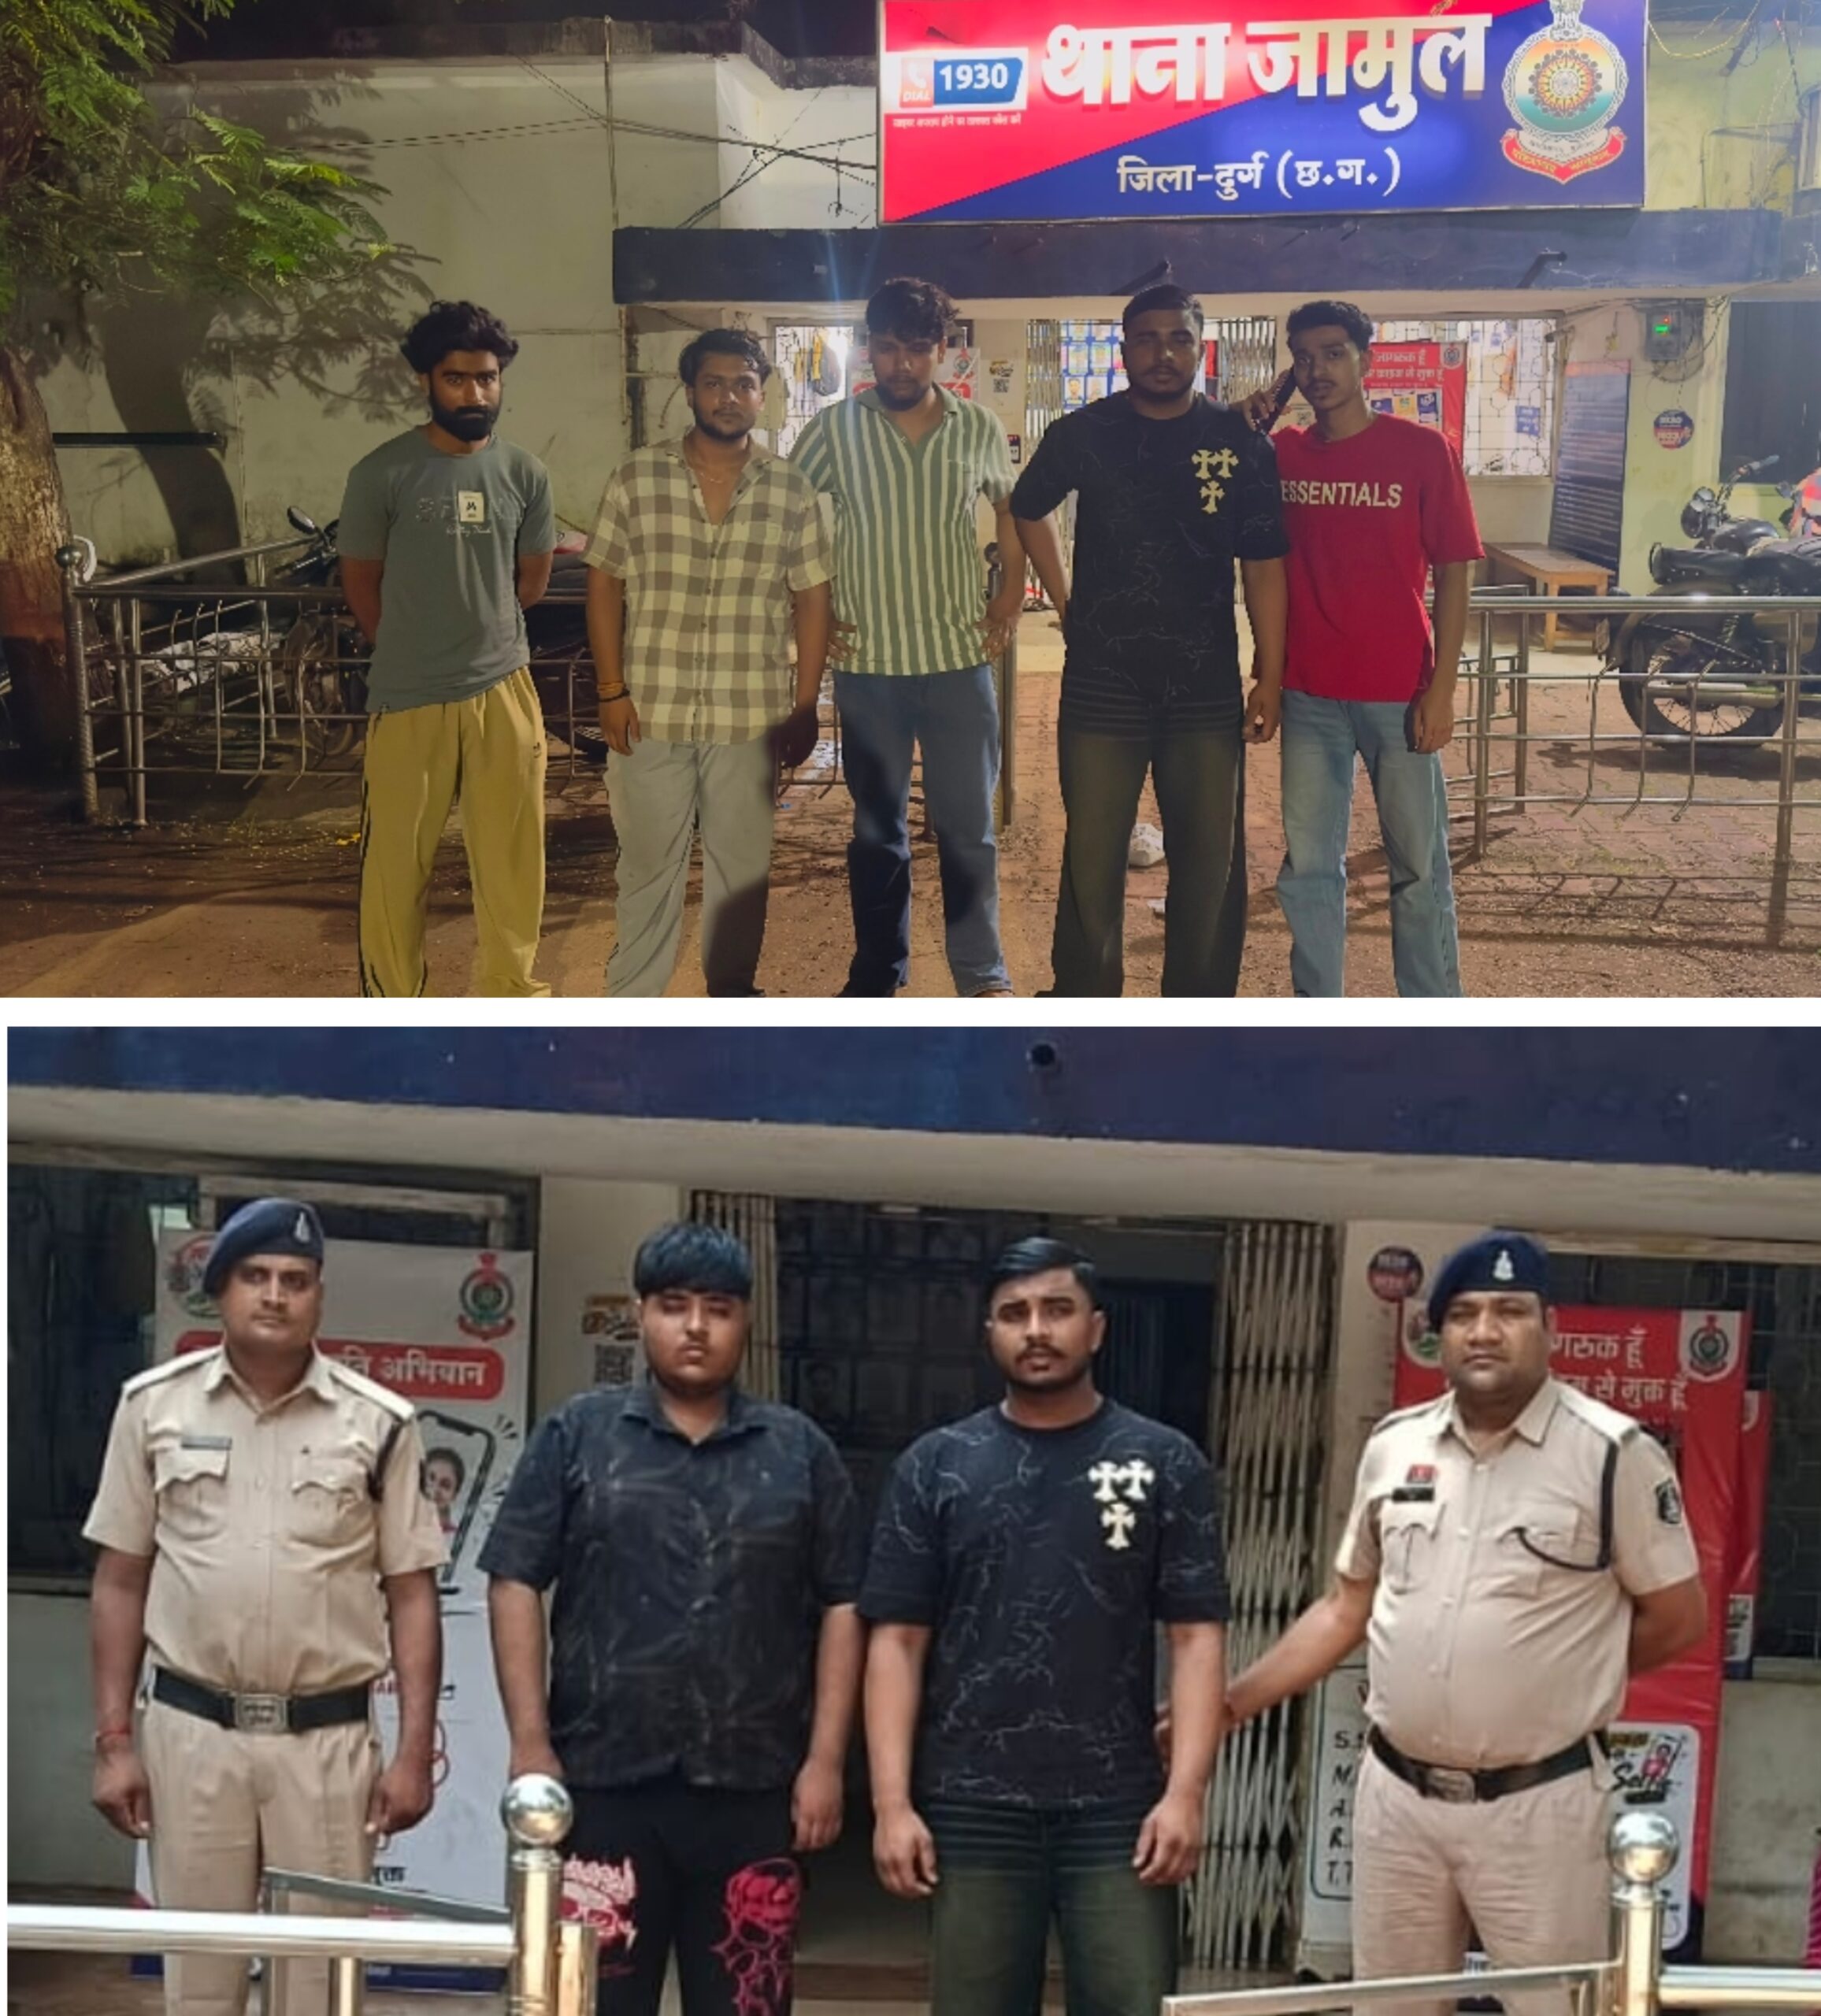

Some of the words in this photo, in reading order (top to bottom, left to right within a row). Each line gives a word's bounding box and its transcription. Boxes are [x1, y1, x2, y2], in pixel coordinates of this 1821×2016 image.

[940, 63, 1008, 91] 1930
[1041, 23, 1232, 105] थाना
[1245, 13, 1493, 132] जामुल
[1116, 150, 1269, 201] जिला-दुर्ग
[1277, 146, 1400, 198] (छ.ग.)
[1279, 479, 1403, 509] ESSENTIALS
[379, 1347, 487, 1386] अभियान
